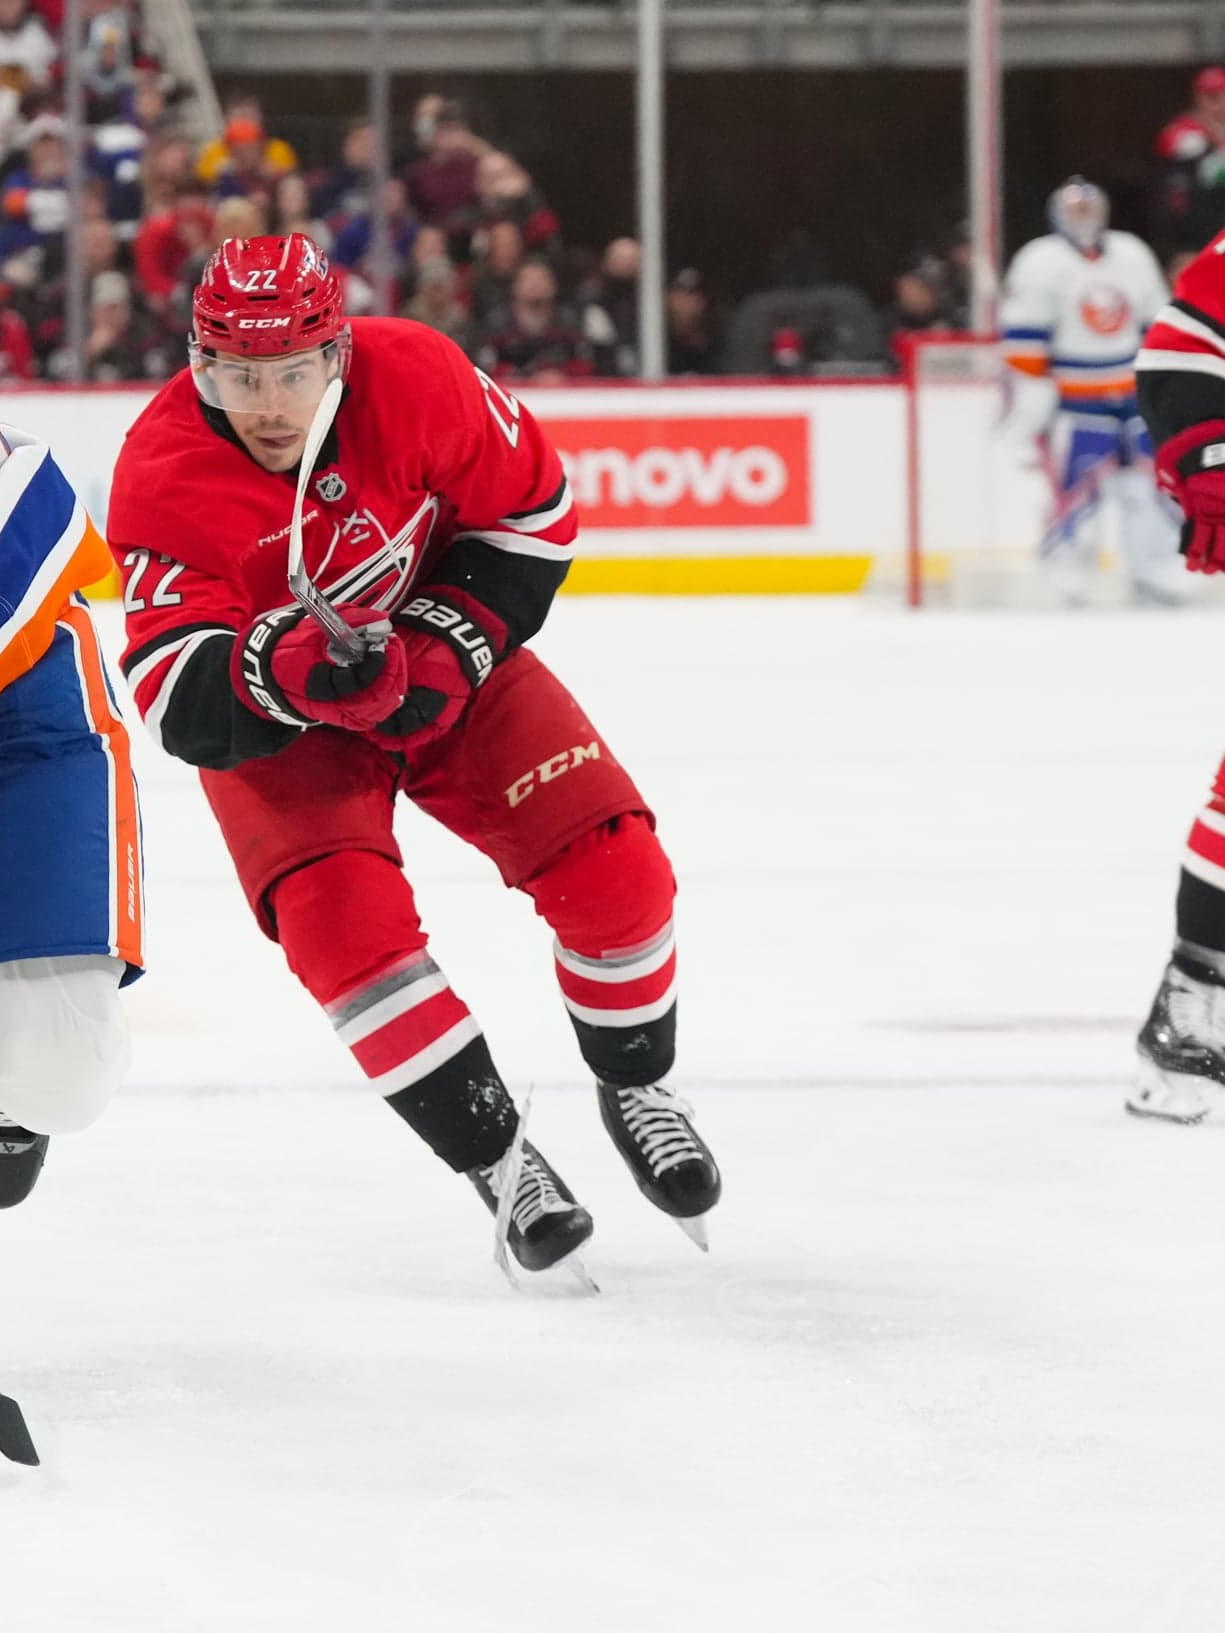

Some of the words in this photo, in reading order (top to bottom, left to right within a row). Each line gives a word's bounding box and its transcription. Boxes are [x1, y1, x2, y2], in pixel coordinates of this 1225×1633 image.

[245, 269, 278, 292] 22
[238, 316, 292, 329] CCM
[123, 547, 187, 615] 22
[504, 741, 600, 808] CCM
